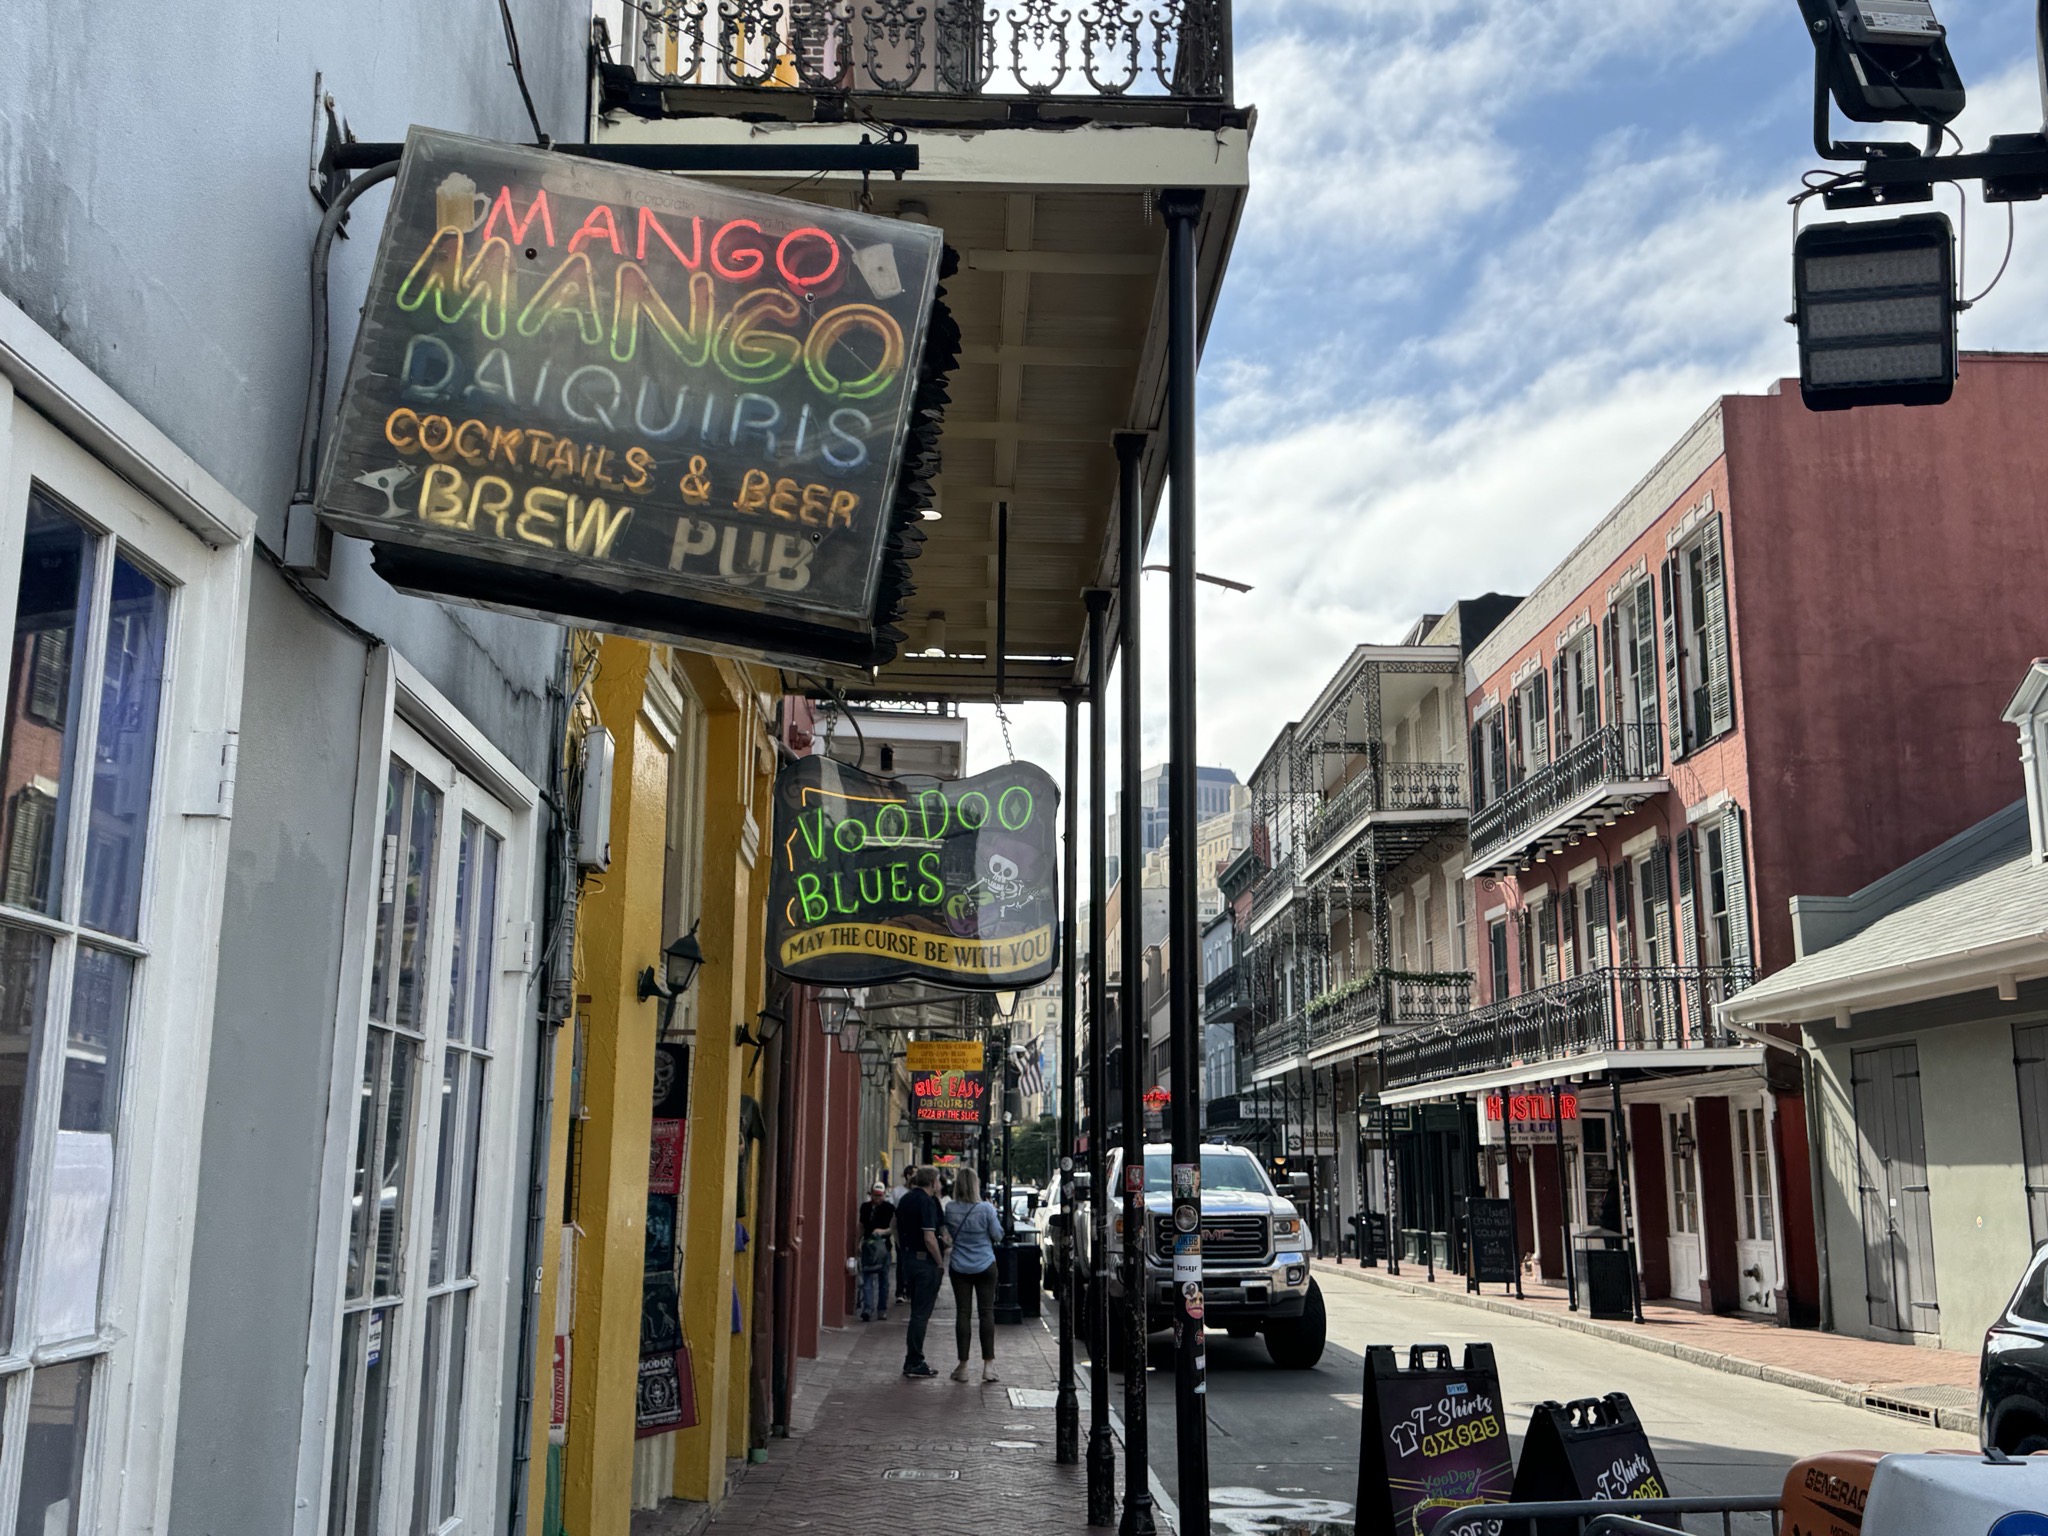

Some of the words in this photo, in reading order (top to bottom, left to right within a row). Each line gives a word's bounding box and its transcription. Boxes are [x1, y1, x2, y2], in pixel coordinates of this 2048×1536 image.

[483, 185, 842, 287] MANGO
[396, 225, 905, 400] MANGO
[402, 334, 873, 475] DAIQUIRIS
[385, 407, 656, 492] COCKTAILS
[679, 455, 712, 502] &
[734, 468, 861, 531] BEER
[417, 463, 635, 560] BREW
[668, 514, 820, 593] PUB
[797, 852, 945, 923] BLUES
[788, 928, 826, 961] MAY
[830, 927, 861, 947] THE
[864, 929, 918, 957] CURSE
[923, 941, 949, 963] BE
[954, 945, 1002, 968] WITH
[1003, 931, 1049, 965] YOU
[914, 1076, 942, 1096] BIG
[949, 1077, 984, 1098] EASY
[918, 1109, 935, 1119] PIZZA
[937, 1110, 945, 1119] BY
[948, 1110, 960, 1120] THE
[961, 1111, 979, 1120] SLICE
[554, 1366, 564, 1421] GENUINE
[1411, 1394, 1493, 1435] T-Shirts
[1597, 1453, 1651, 1500] T-Shirts
[1804, 1467, 1868, 1513] GENERAC
